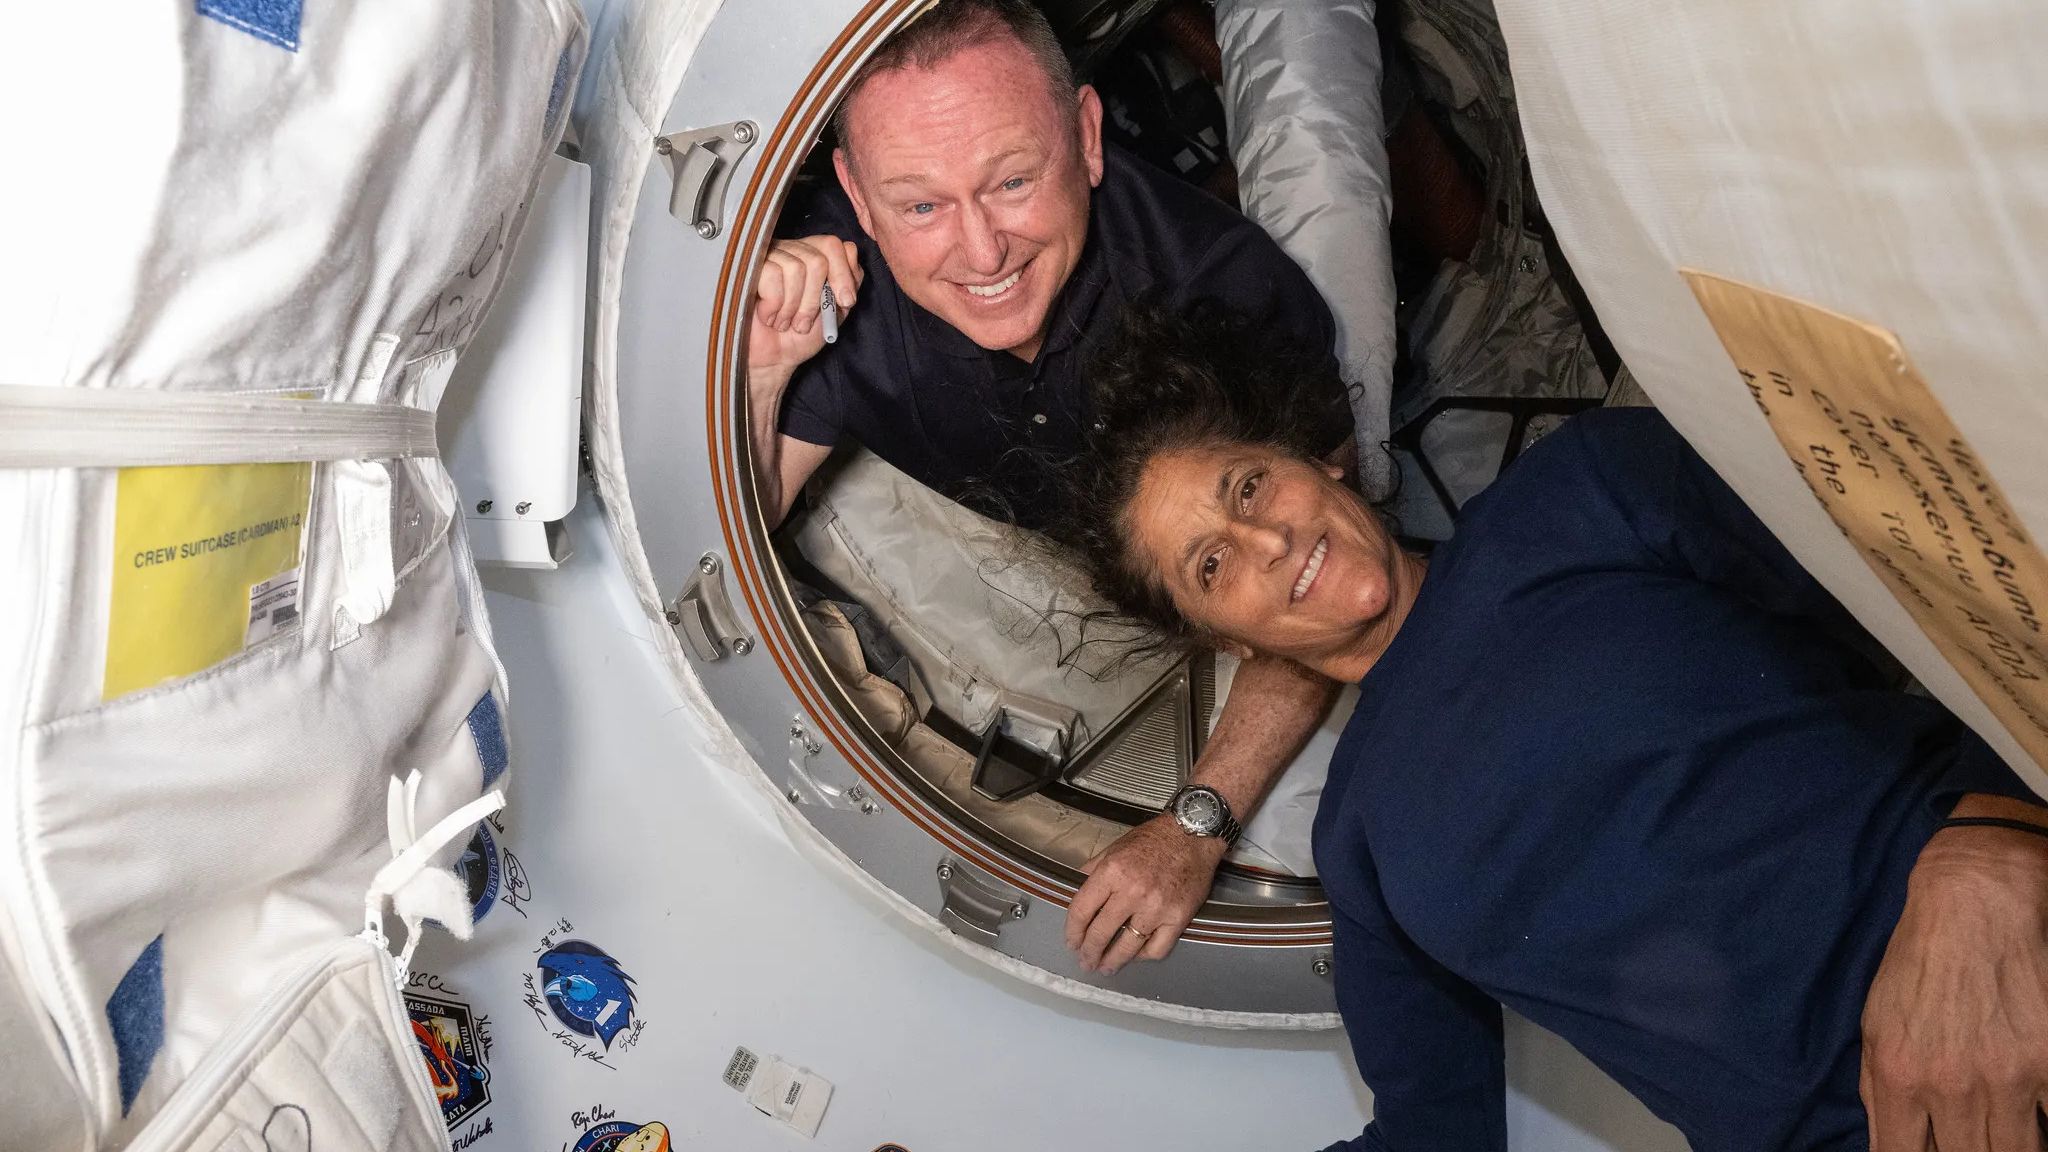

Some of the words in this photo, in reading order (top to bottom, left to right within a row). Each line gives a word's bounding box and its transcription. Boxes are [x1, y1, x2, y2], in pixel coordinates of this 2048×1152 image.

[1767, 369, 1794, 398] in
[1808, 443, 1846, 496] the
[1811, 389, 1880, 480] cover
[135, 546, 177, 568] CREW
[181, 532, 236, 559] SUITCASE
[486, 857, 499, 899] ФЕДЯЕВ
[405, 1000, 445, 1016] ASSADA
[726, 1049, 745, 1080] RESTRAINT
[738, 1053, 751, 1073] WATER
[745, 1057, 757, 1073] FUEL
[738, 1072, 750, 1087] CELL
[592, 1124, 620, 1139] CHARI
